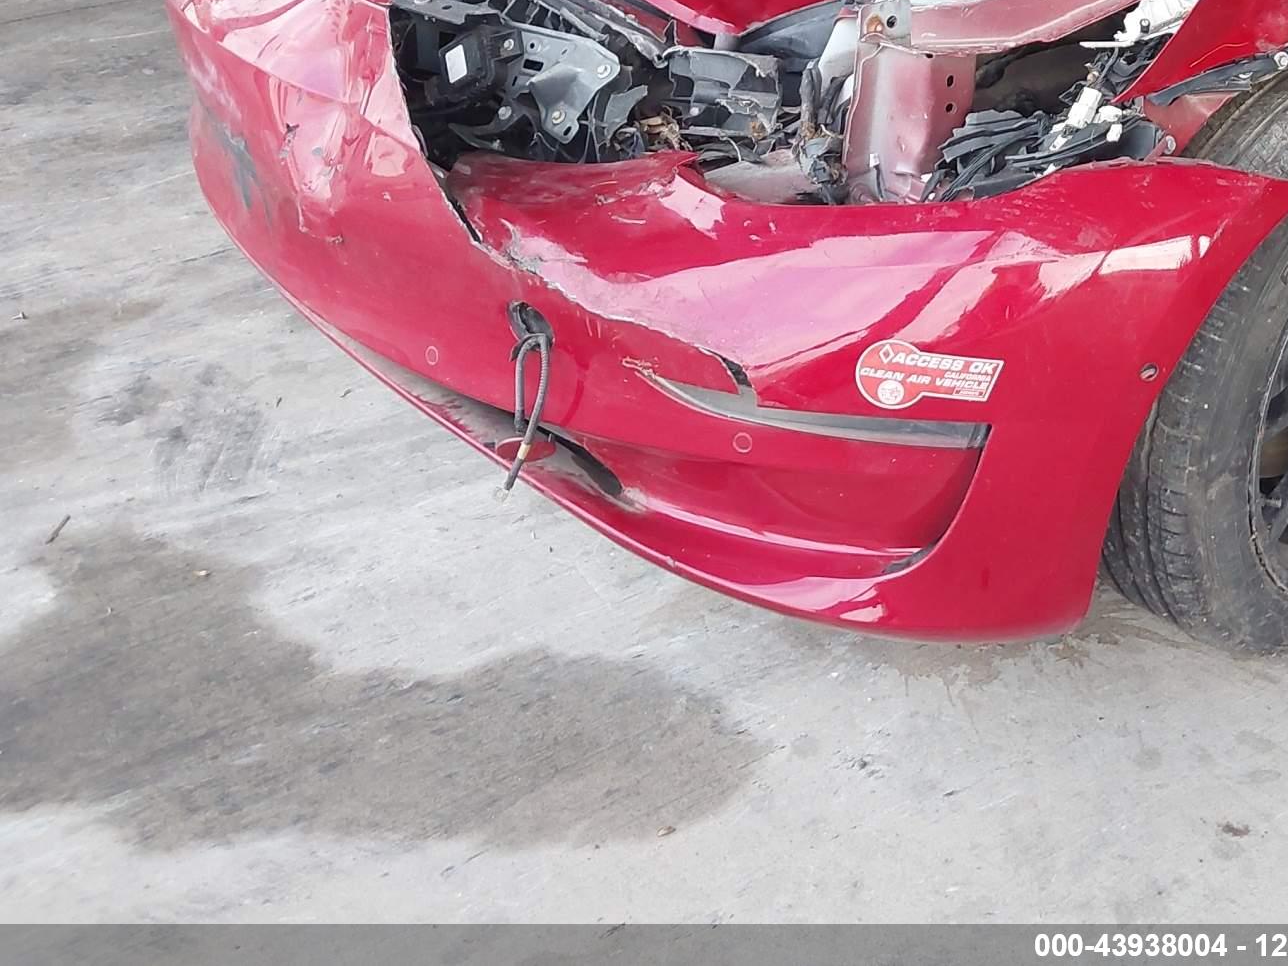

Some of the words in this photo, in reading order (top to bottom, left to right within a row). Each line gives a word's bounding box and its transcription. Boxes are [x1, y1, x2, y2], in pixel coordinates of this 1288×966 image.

[892, 352, 965, 371] ACCESS
[968, 361, 998, 375] OK
[860, 367, 905, 381] CLEAN
[906, 374, 932, 384] AIR
[935, 377, 990, 390] VEHICLE
